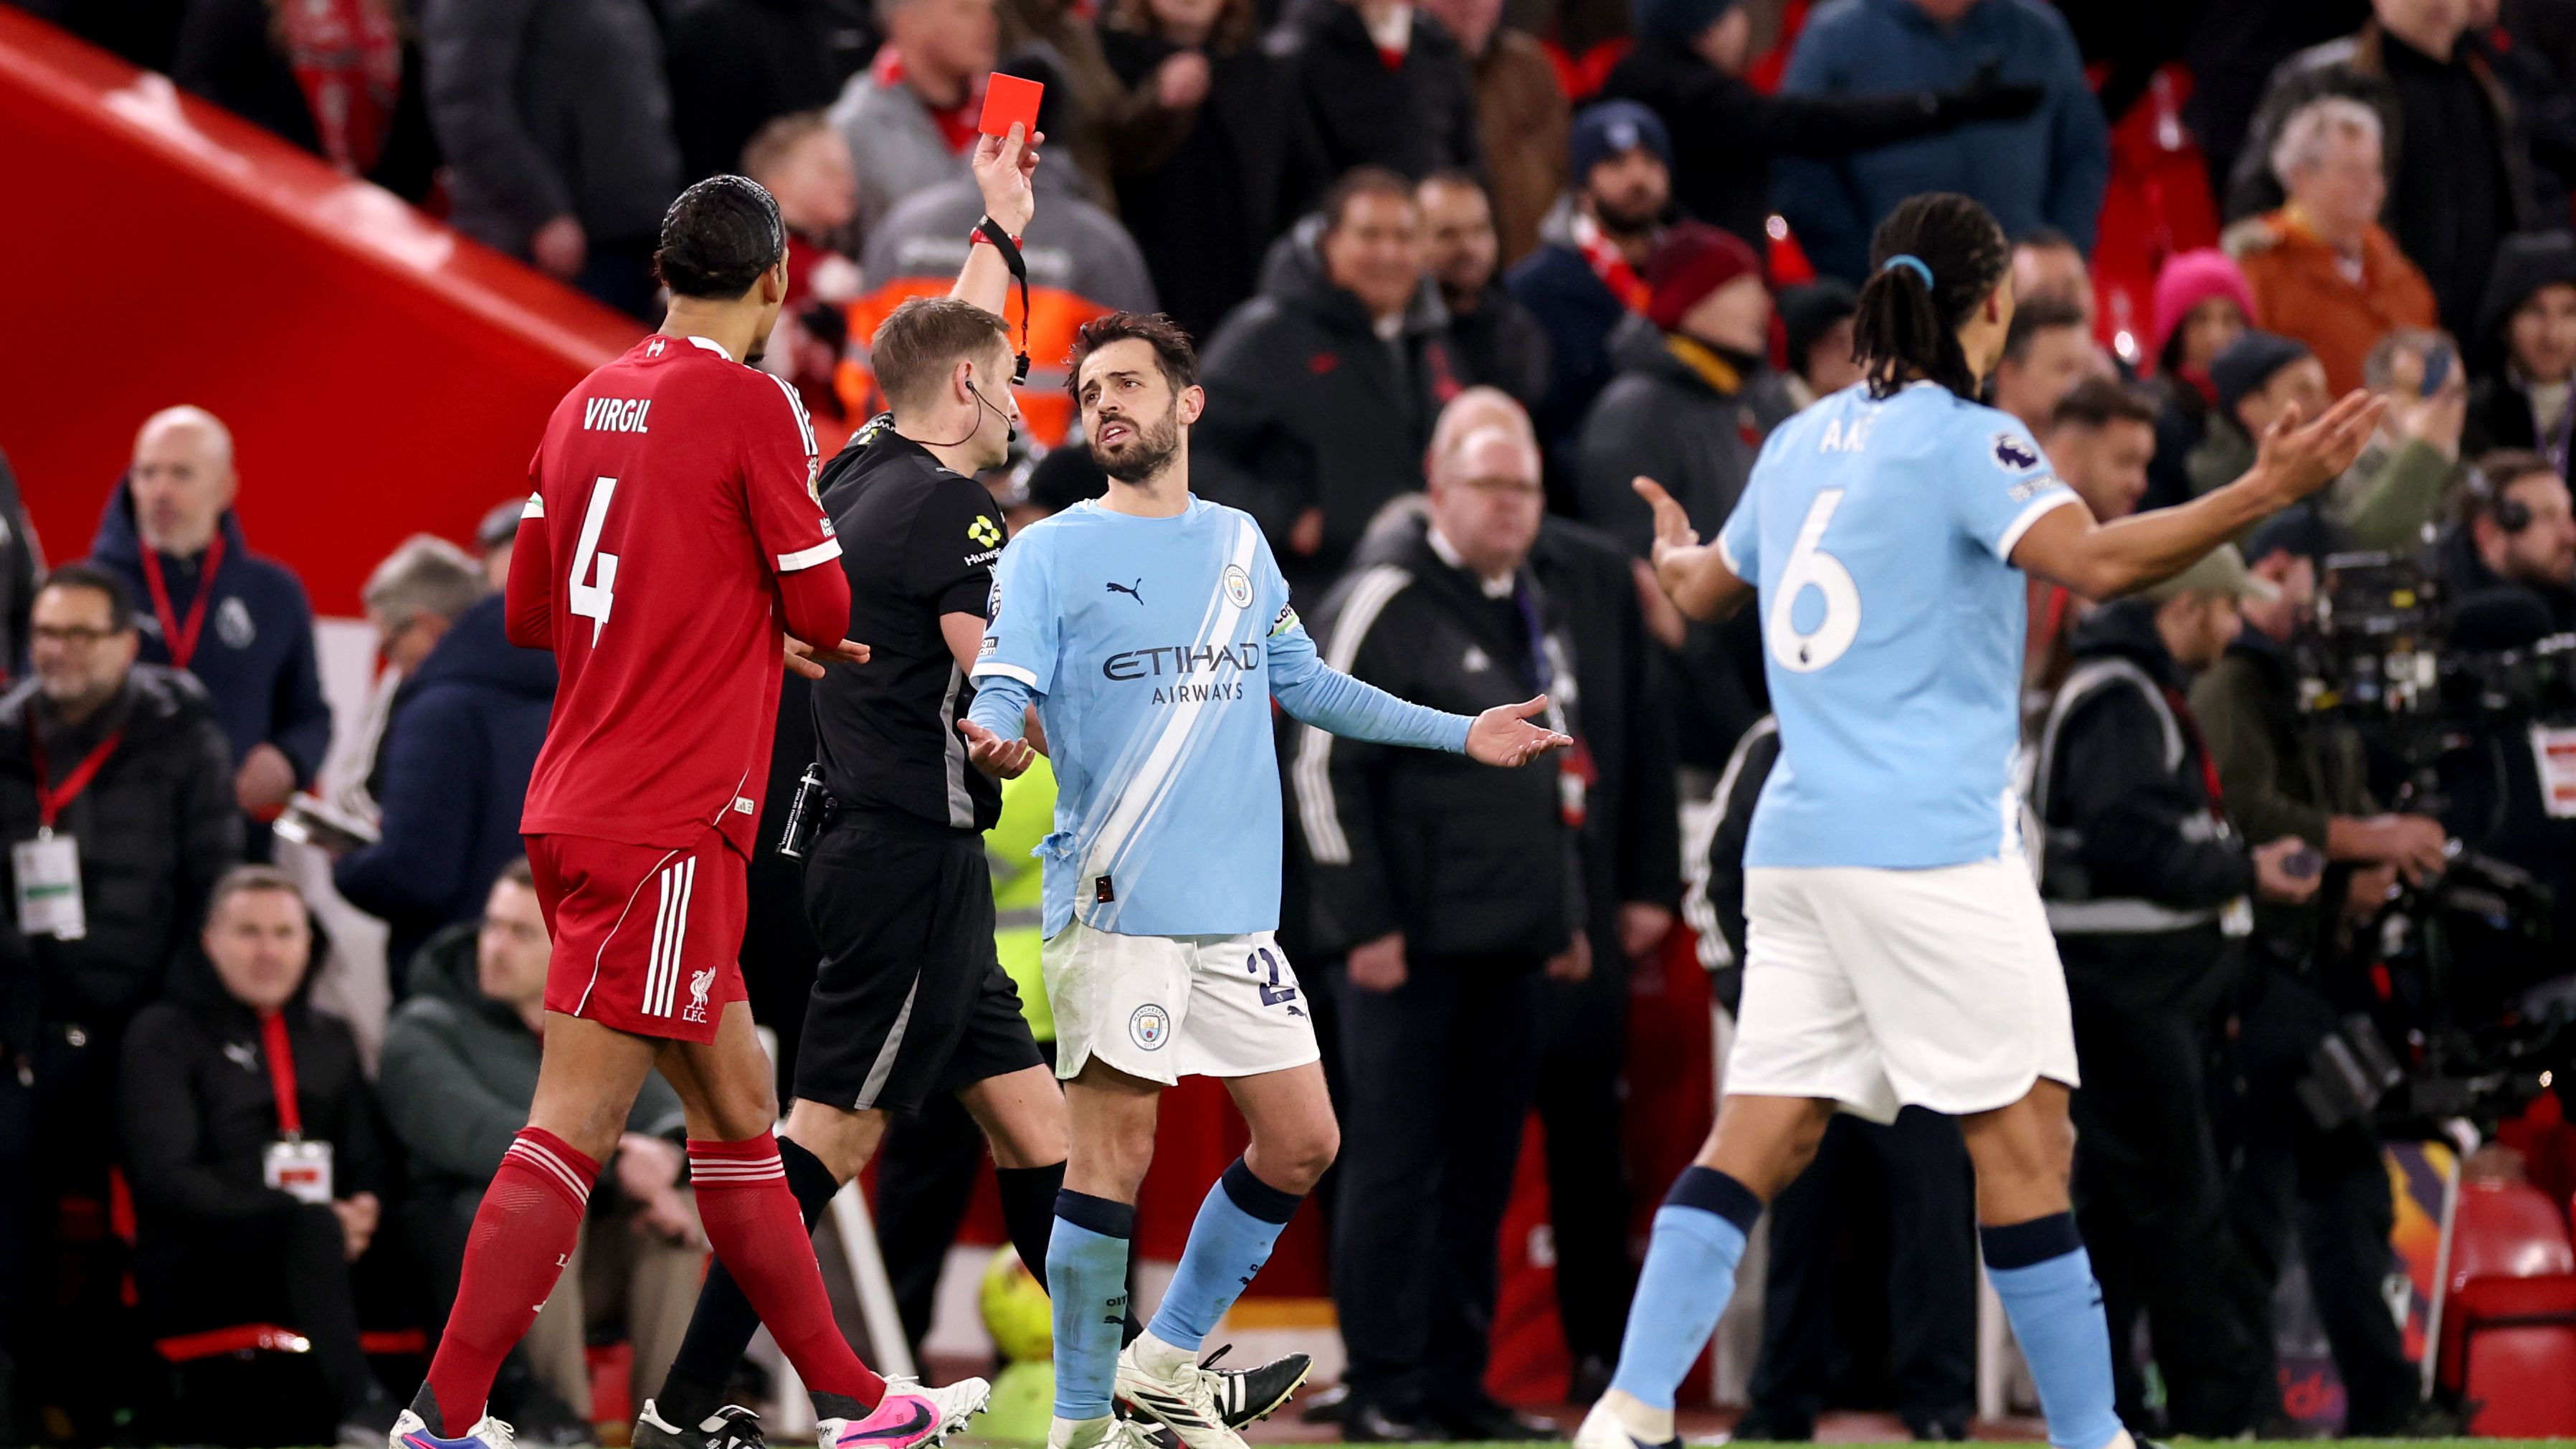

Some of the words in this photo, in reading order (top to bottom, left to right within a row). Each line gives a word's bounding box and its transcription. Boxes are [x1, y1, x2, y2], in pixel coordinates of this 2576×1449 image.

[584, 397, 652, 434] VIRGIL
[569, 477, 619, 649] 4
[1769, 488, 1863, 674] 6
[1103, 643, 1260, 680] ETIHAD
[1151, 682, 1242, 705] AIRWAYS
[1133, 1007, 1166, 1022] MANCHESTER
